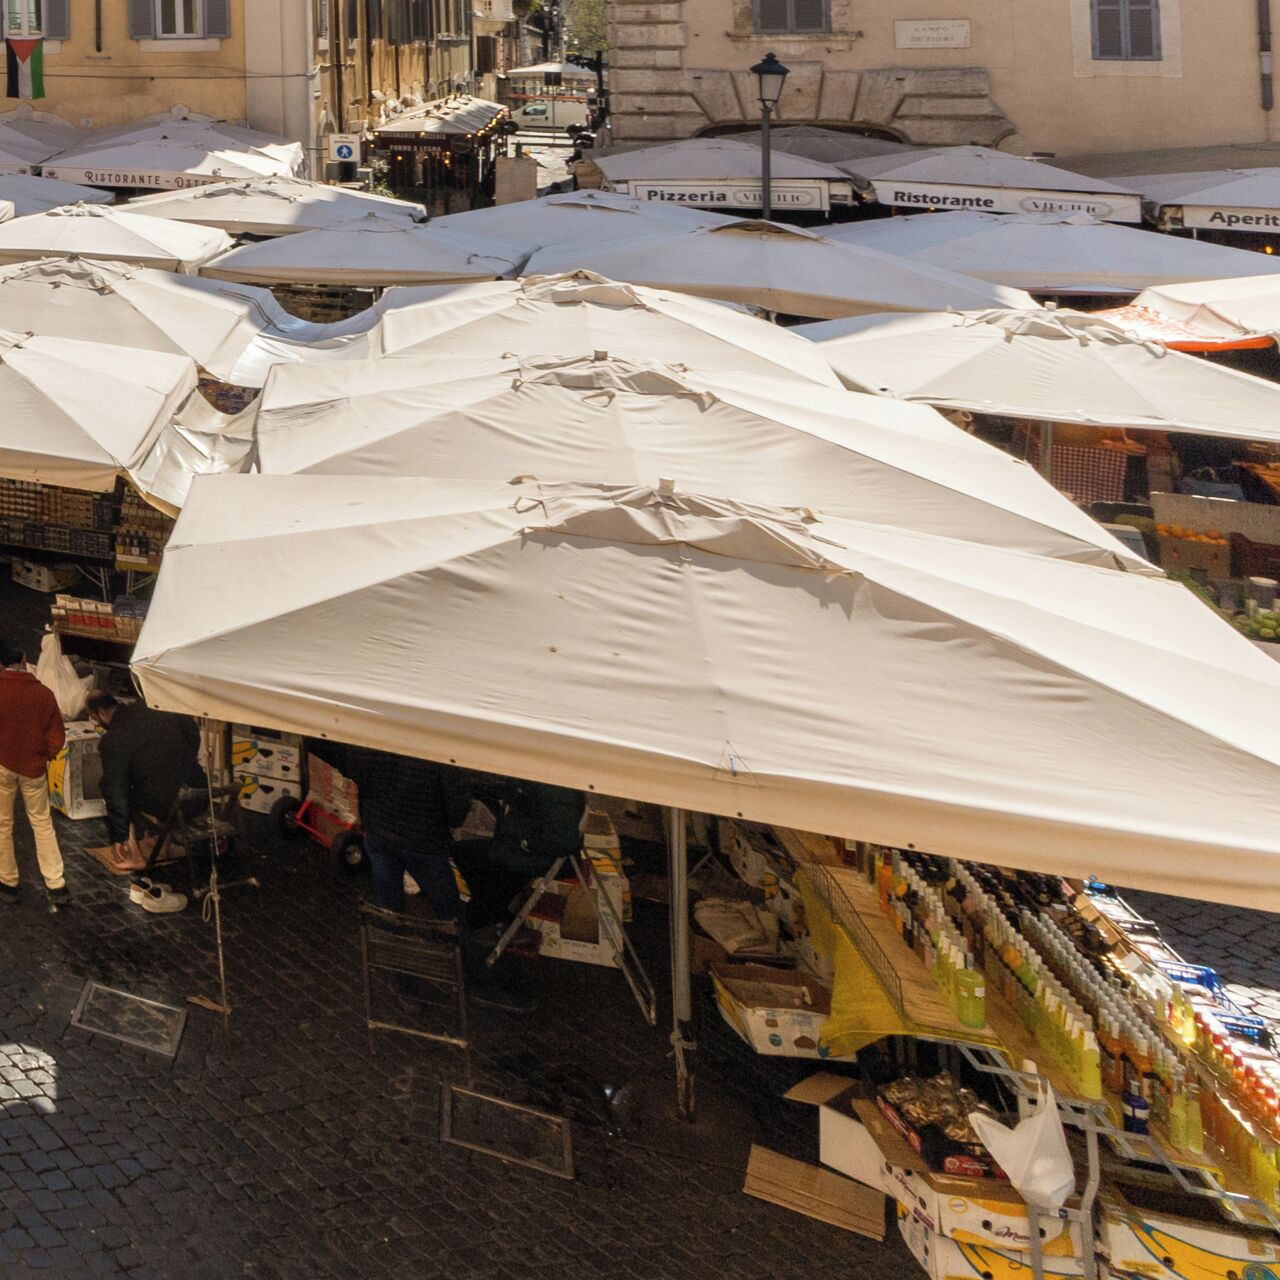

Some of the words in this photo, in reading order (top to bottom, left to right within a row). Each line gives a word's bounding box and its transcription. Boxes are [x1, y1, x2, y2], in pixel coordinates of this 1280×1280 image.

[84, 170, 161, 185] RISTORANTE
[175, 176, 215, 189] OSTE
[647, 190, 727, 202] Pizzeria
[893, 190, 994, 208] Ristorante
